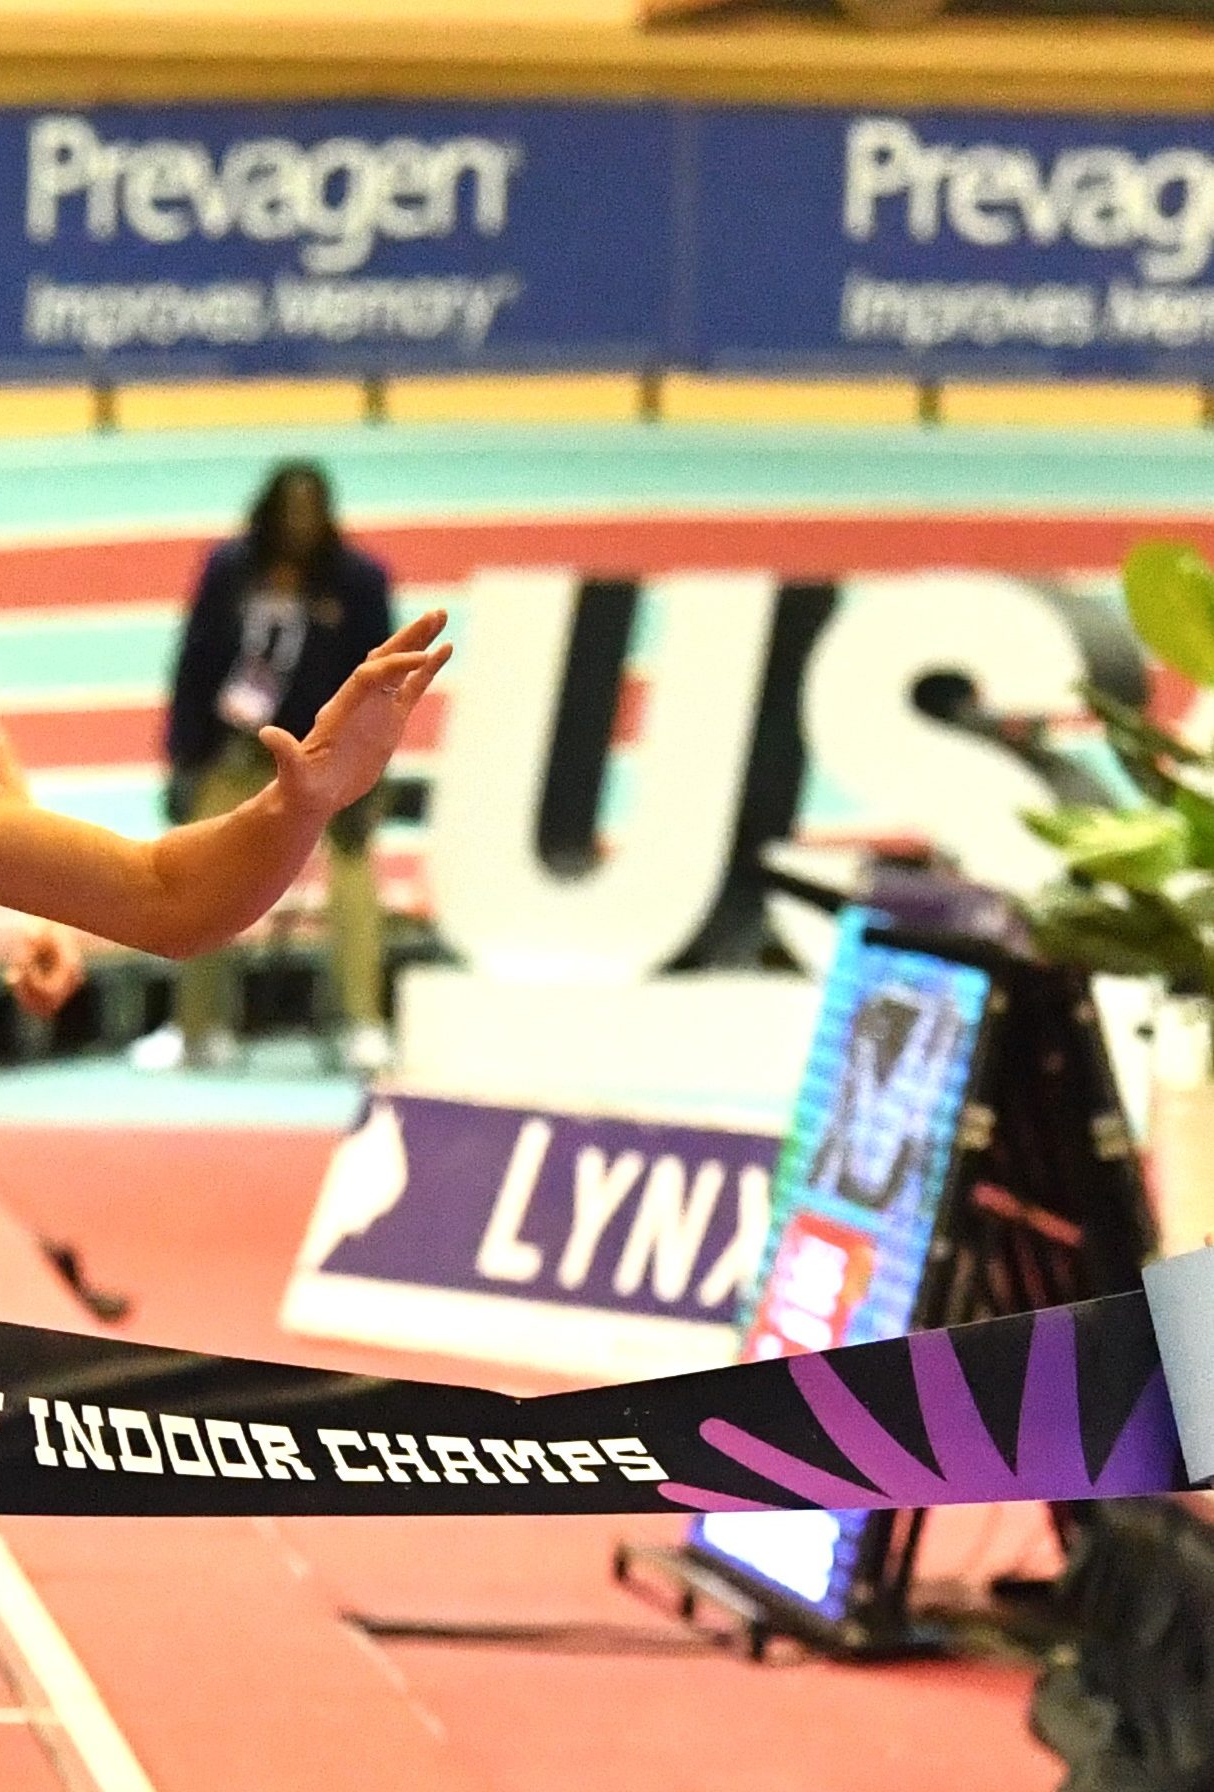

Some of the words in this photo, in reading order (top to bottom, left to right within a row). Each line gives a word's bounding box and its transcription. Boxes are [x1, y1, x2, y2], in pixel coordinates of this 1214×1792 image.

[24, 116, 512, 276] Prevagen
[28, 1396, 317, 1481] INDOOR
[317, 1427, 670, 1484] CHAMPS
